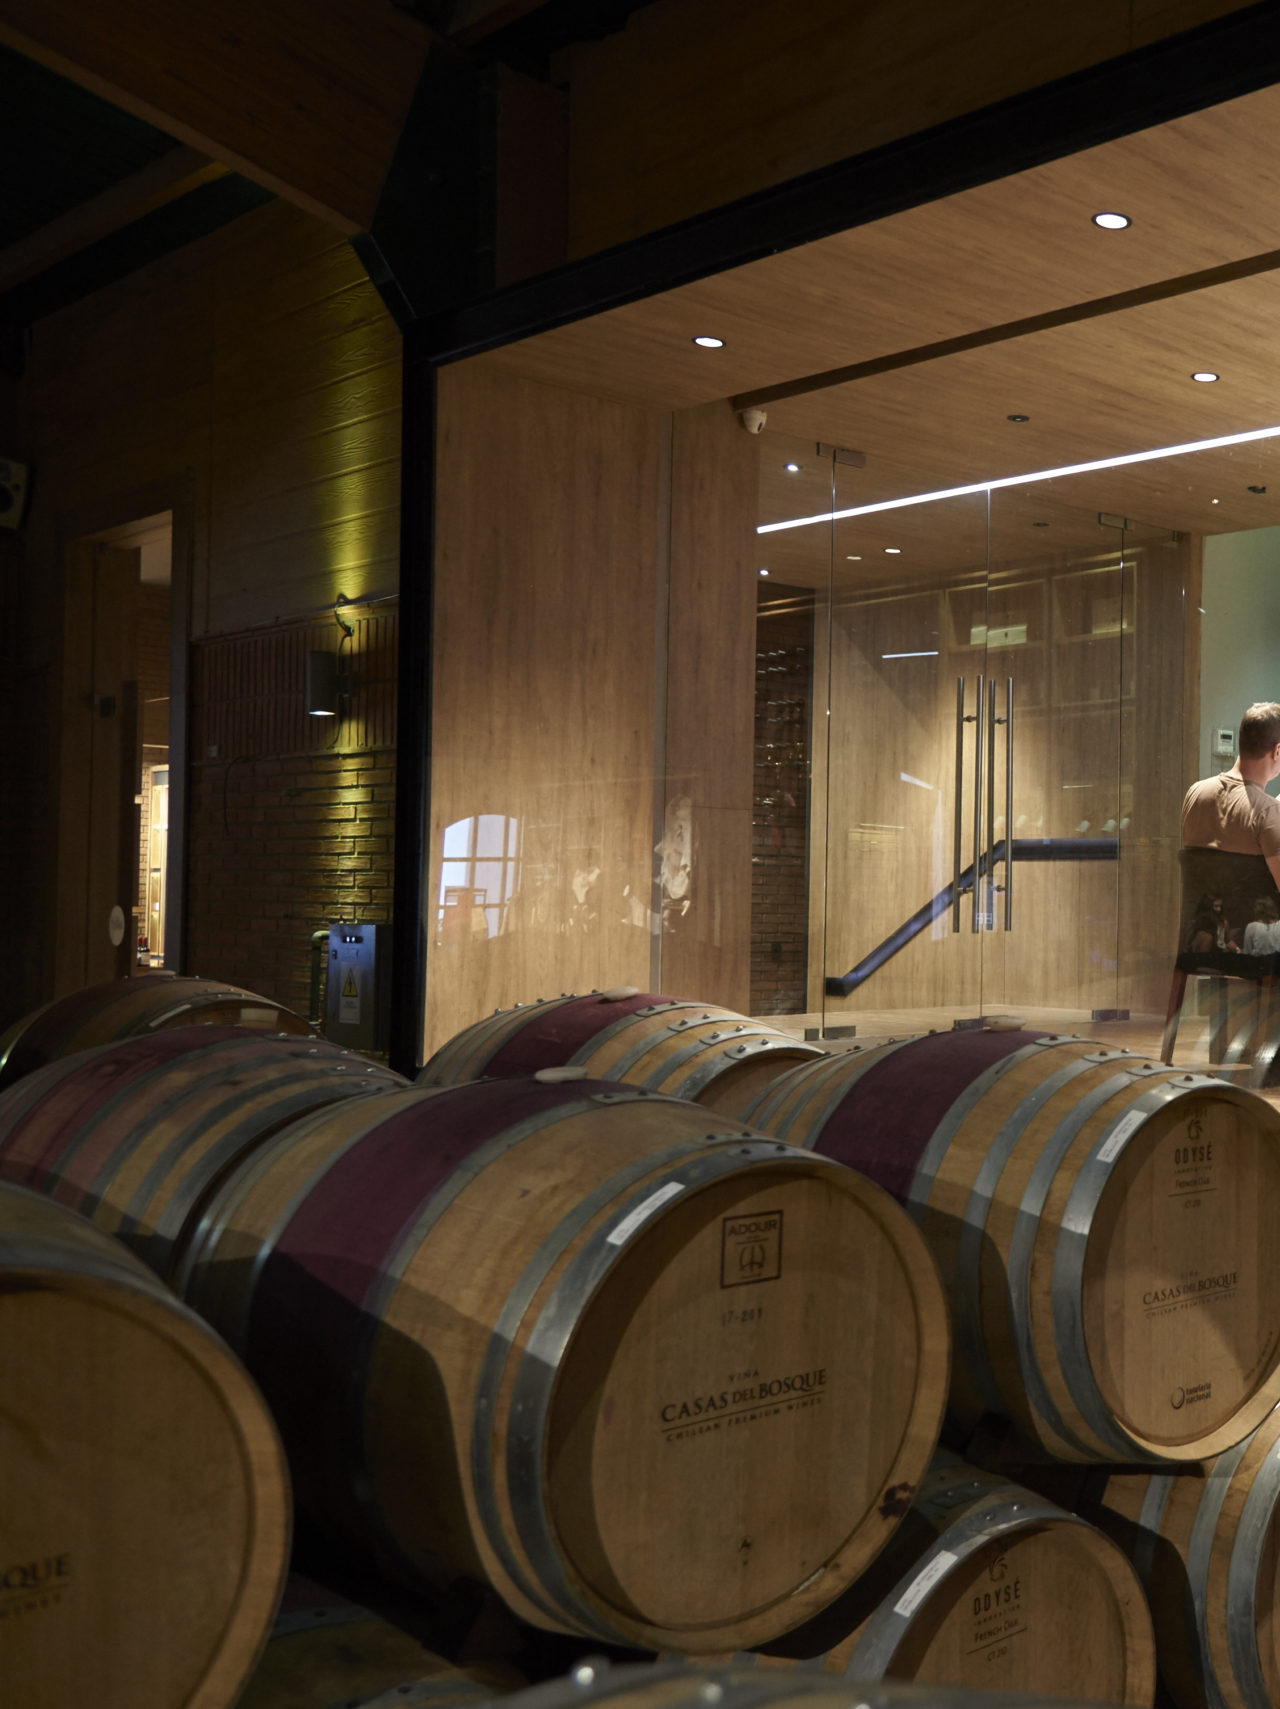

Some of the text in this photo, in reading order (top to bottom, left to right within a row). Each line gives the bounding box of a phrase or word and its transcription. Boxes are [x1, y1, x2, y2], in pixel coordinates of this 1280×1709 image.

[1174, 1140, 1213, 1165] ODYSÉ
[728, 1219, 778, 1236] ADOUR
[1142, 1285, 1182, 1305] CASAS
[1198, 1271, 1239, 1292] BOSQUE
[660, 1368, 827, 1423] CASAS DEL BOSQUE
[0, 1552, 72, 1590] QUE
[973, 1576, 1021, 1615] ODYSÉ
